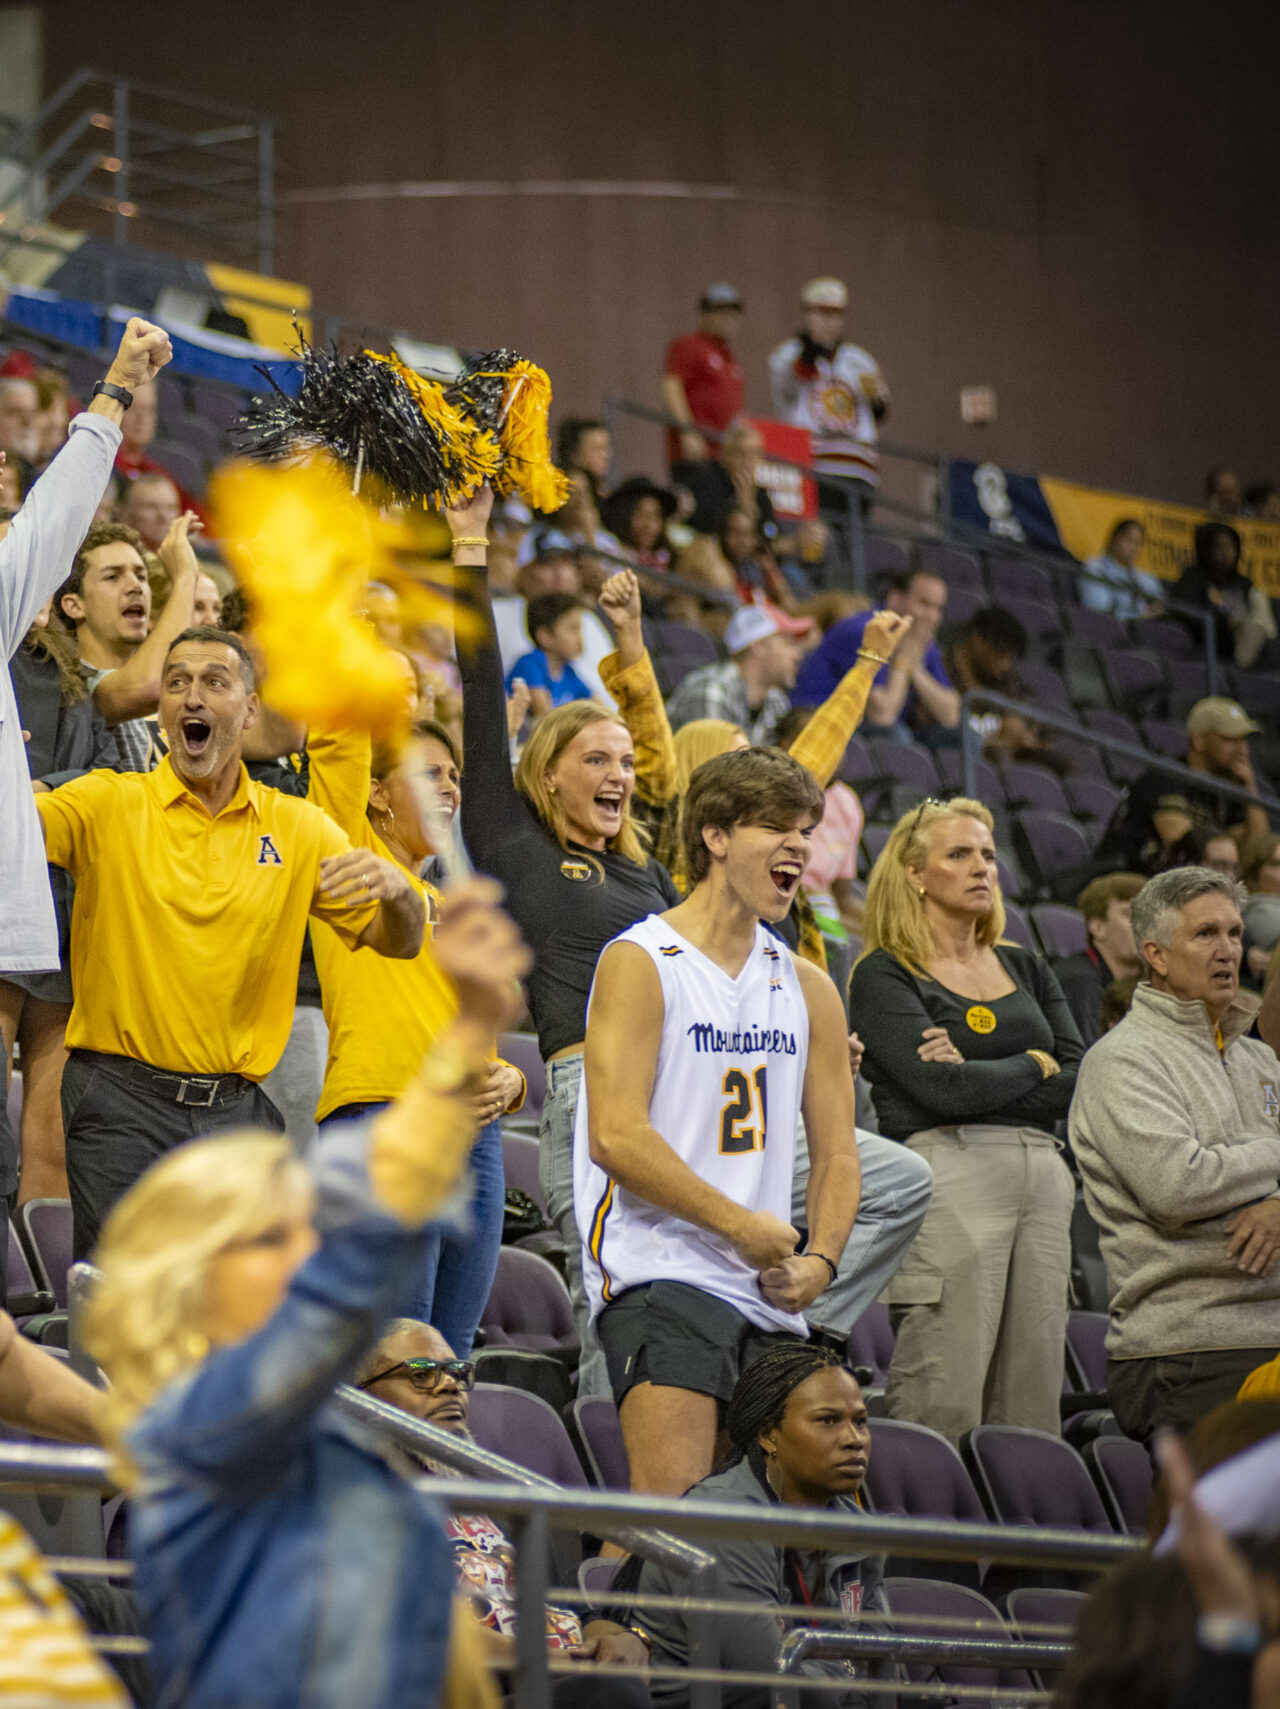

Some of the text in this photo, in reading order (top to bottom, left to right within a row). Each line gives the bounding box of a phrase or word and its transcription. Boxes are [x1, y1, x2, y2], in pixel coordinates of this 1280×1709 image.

[256, 833, 283, 867] A
[687, 1022, 796, 1055] Mountaineers
[718, 1063, 767, 1156] 21
